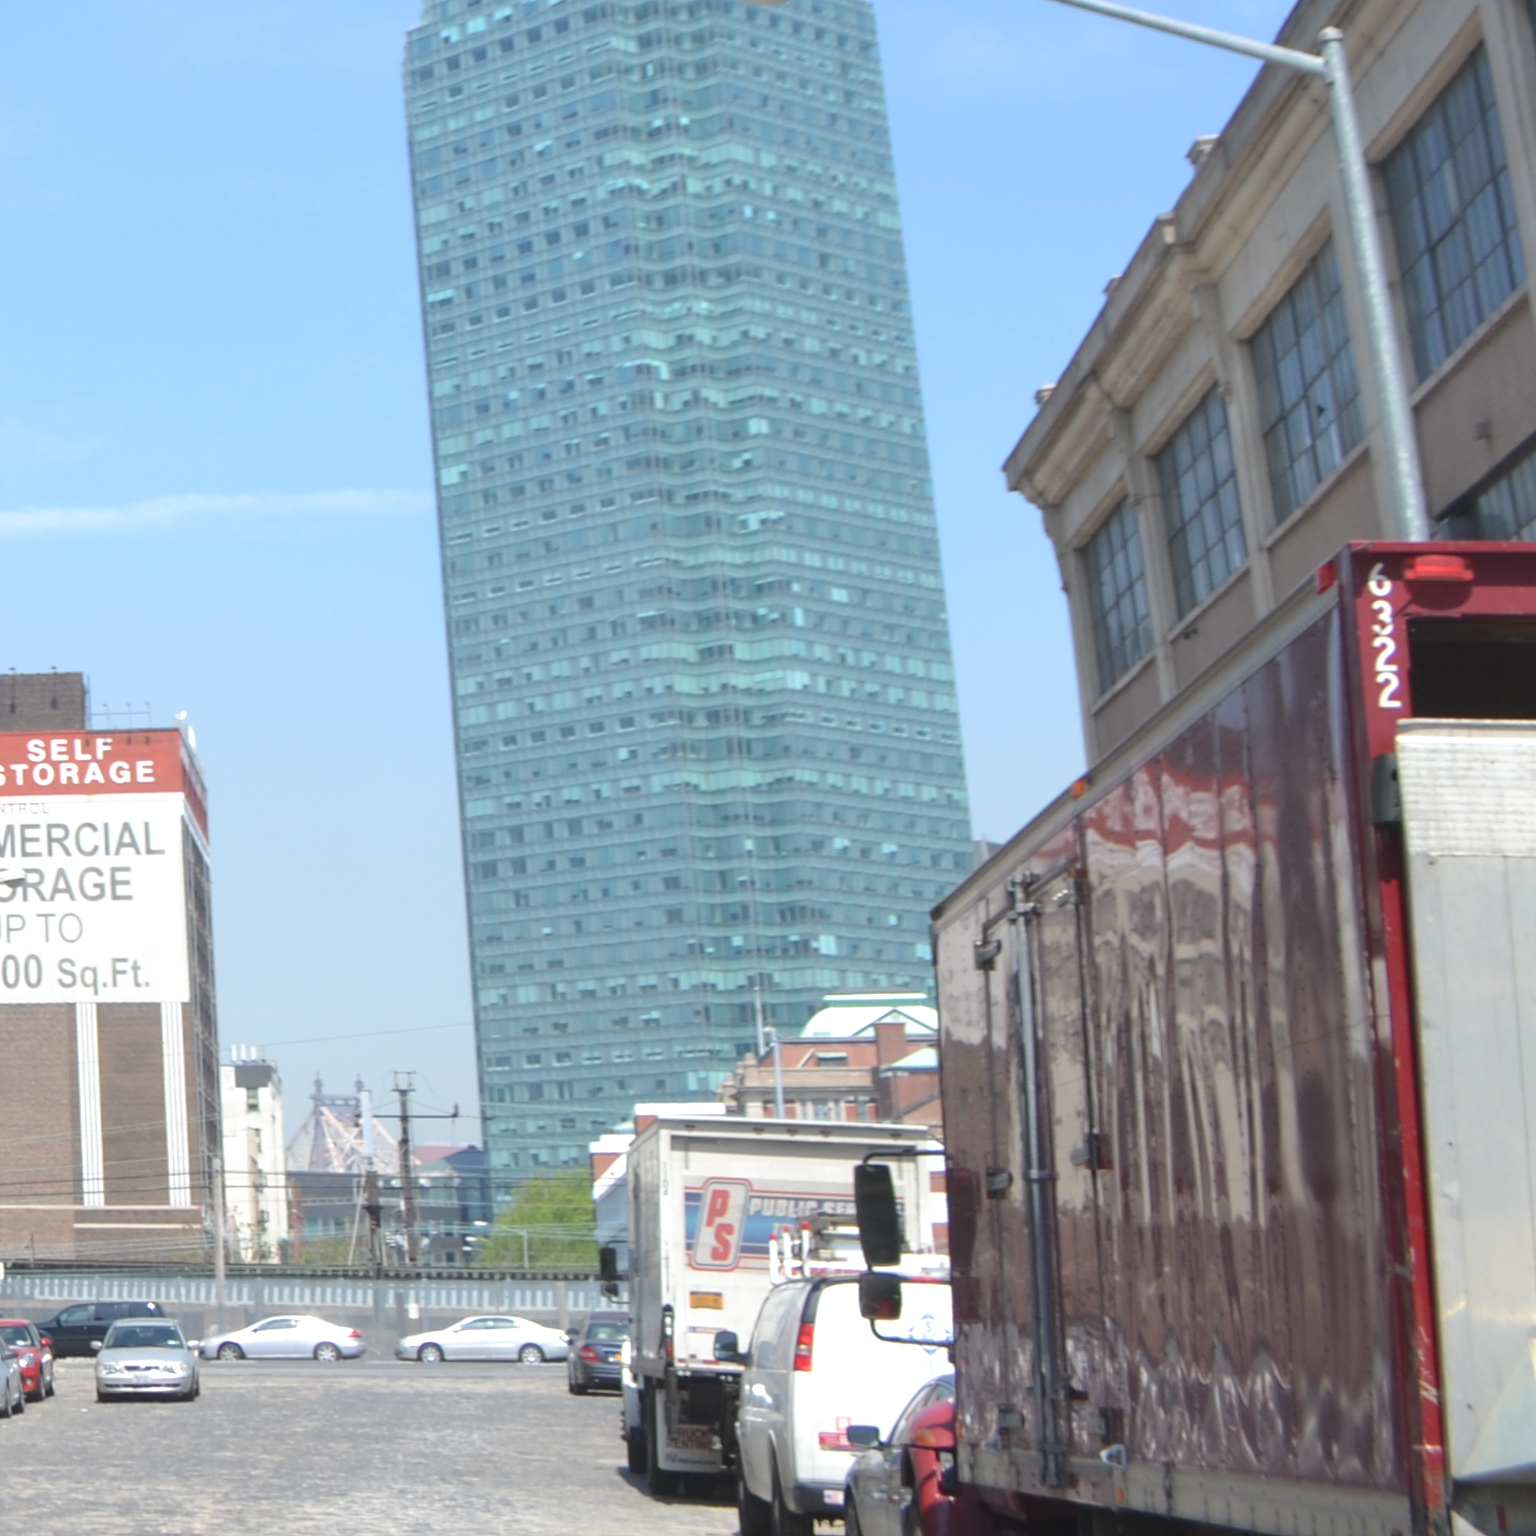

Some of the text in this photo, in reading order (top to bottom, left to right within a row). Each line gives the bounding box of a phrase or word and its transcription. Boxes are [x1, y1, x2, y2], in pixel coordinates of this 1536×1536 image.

[1366, 562, 1403, 708] 6322
[26, 738, 114, 763] SELF
[36, 913, 84, 944] TO
[56, 956, 152, 996] Sq.Ft.
[748, 1197, 819, 1218] PUBLIC
